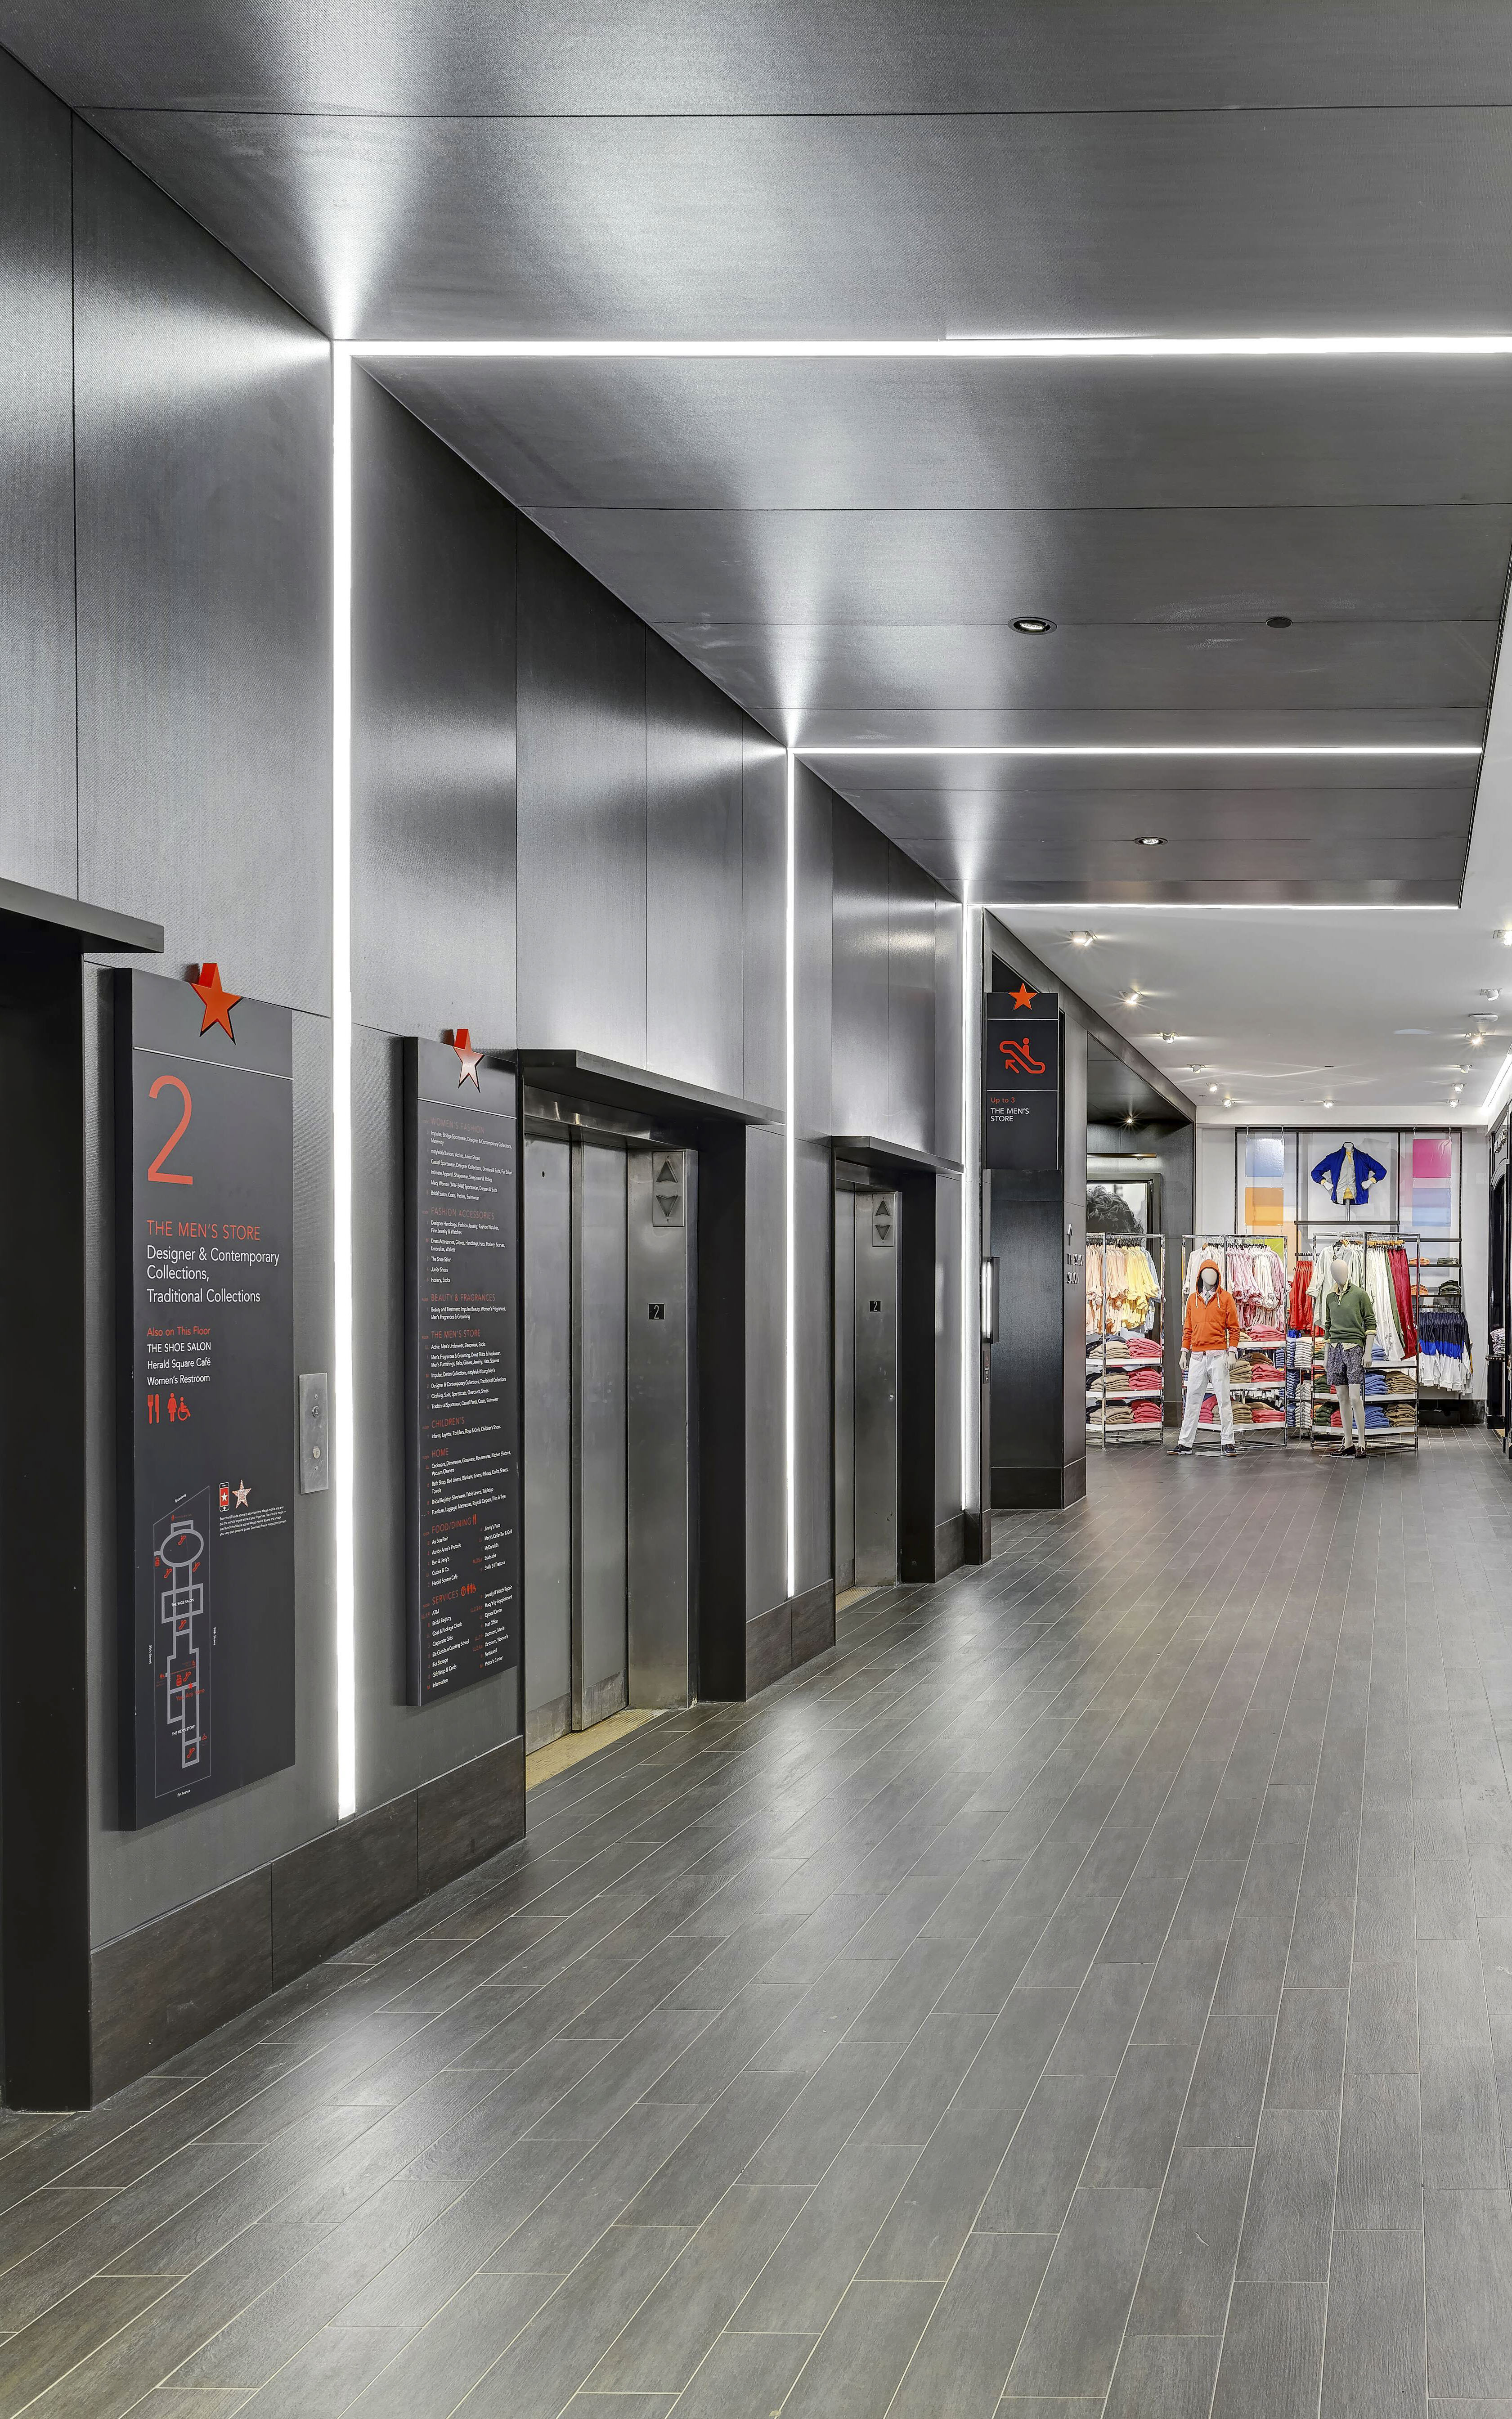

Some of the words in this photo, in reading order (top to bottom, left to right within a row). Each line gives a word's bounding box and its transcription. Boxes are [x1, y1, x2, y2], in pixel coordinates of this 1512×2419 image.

[147, 1075, 193, 1185] 2
[431, 1117, 458, 1129] WOMEN'S
[461, 1123, 484, 1134] FASHION
[431, 1207, 456, 1216] FASHION
[459, 1209, 494, 1220] ACCESSORIES
[147, 1220, 173, 1236] THE
[178, 1221, 218, 1239] MEN'S
[223, 1225, 261, 1241] STORE
[147, 1245, 196, 1264] Designer
[199, 1247, 207, 1261] &
[211, 1248, 280, 1266] Contemporary
[147, 1265, 210, 1282] Collections,
[147, 1288, 202, 1303] Traditional
[206, 1288, 260, 1303] Collections
[654, 1305, 659, 1319] 2
[873, 1301, 878, 1311] 2
[147, 1328, 163, 1337] Also
[177, 1326, 191, 1336] This
[193, 1326, 211, 1336] Floor
[444, 1330, 461, 1338] MEN'S
[147, 1343, 162, 1353] THE
[164, 1342, 185, 1352] SHOE
[187, 1342, 211, 1351] SALON
[147, 1359, 170, 1369] Herald
[171, 1359, 194, 1370] Square
[196, 1357, 211, 1367] Café
[147, 1375, 178, 1386] Women's
[180, 1374, 210, 1384] Restroom
[432, 1417, 464, 1428] CHILDREN'S
[432, 1448, 448, 1457] HOME
[432, 1517, 471, 1533] FOOD/DINING
[432, 1590, 458, 1605] SERVICES
[433, 1679, 448, 1687] Information
